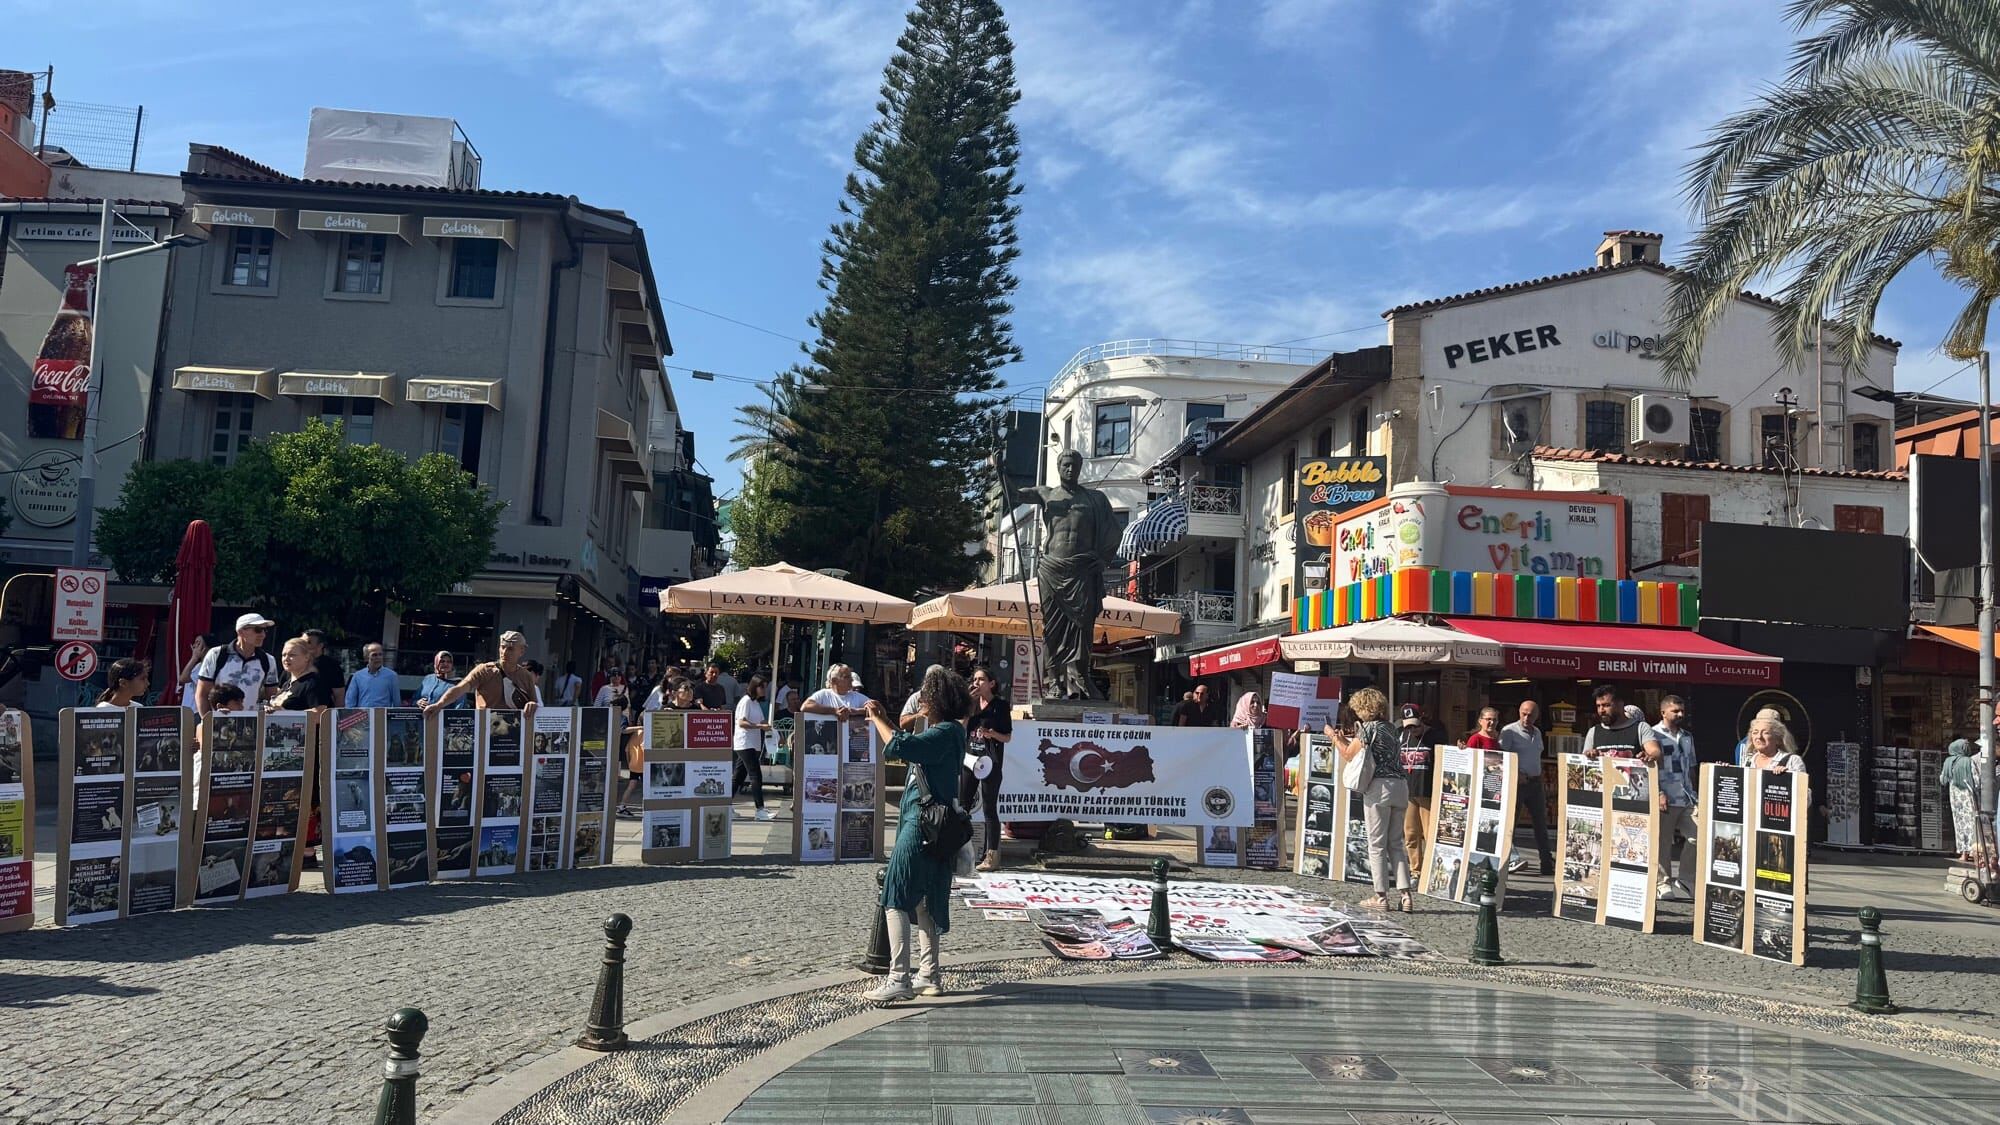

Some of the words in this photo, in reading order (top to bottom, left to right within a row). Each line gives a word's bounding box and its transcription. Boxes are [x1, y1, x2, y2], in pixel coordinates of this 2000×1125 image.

[23, 227, 62, 237] Artimo
[67, 227, 93, 237] Cafe
[1444, 324, 1562, 369] PEKER
[1301, 460, 1383, 486] Bubble
[1568, 505, 1597, 514] DEVREN
[489, 553, 519, 563] offee
[529, 553, 571, 569] Bakery
[641, 586, 662, 594] LAVAZ
[723, 593, 745, 605] LA
[755, 595, 865, 614] GELATERIA
[997, 601, 1019, 613] LA
[1379, 643, 1440, 653] GELATERIA
[1460, 647, 1470, 655] LA
[1598, 659, 1637, 673] ENERJİ
[1643, 660, 1687, 675] VİTAMİN
[1037, 728, 1052, 738] TEK
[1054, 728, 1069, 738] SES
[1071, 729, 1086, 738] TEK
[1088, 729, 1105, 741] GÜÇ
[1106, 730, 1121, 740] TEK
[1123, 730, 1151, 741] ÇÖZÜM
[998, 793, 1036, 804] HAYVAN
[1038, 793, 1082, 804] HAKLARI
[1084, 795, 1142, 806] PLATFORMU
[1144, 795, 1186, 807] TÜRKİYE
[999, 804, 1038, 814] ANTALYA
[1040, 804, 1080, 815] HAYVAN
[1082, 806, 1125, 816] HAKLARI
[1127, 807, 1186, 818] PLATFORMU
[1764, 800, 1789, 817] ÖLÜM
